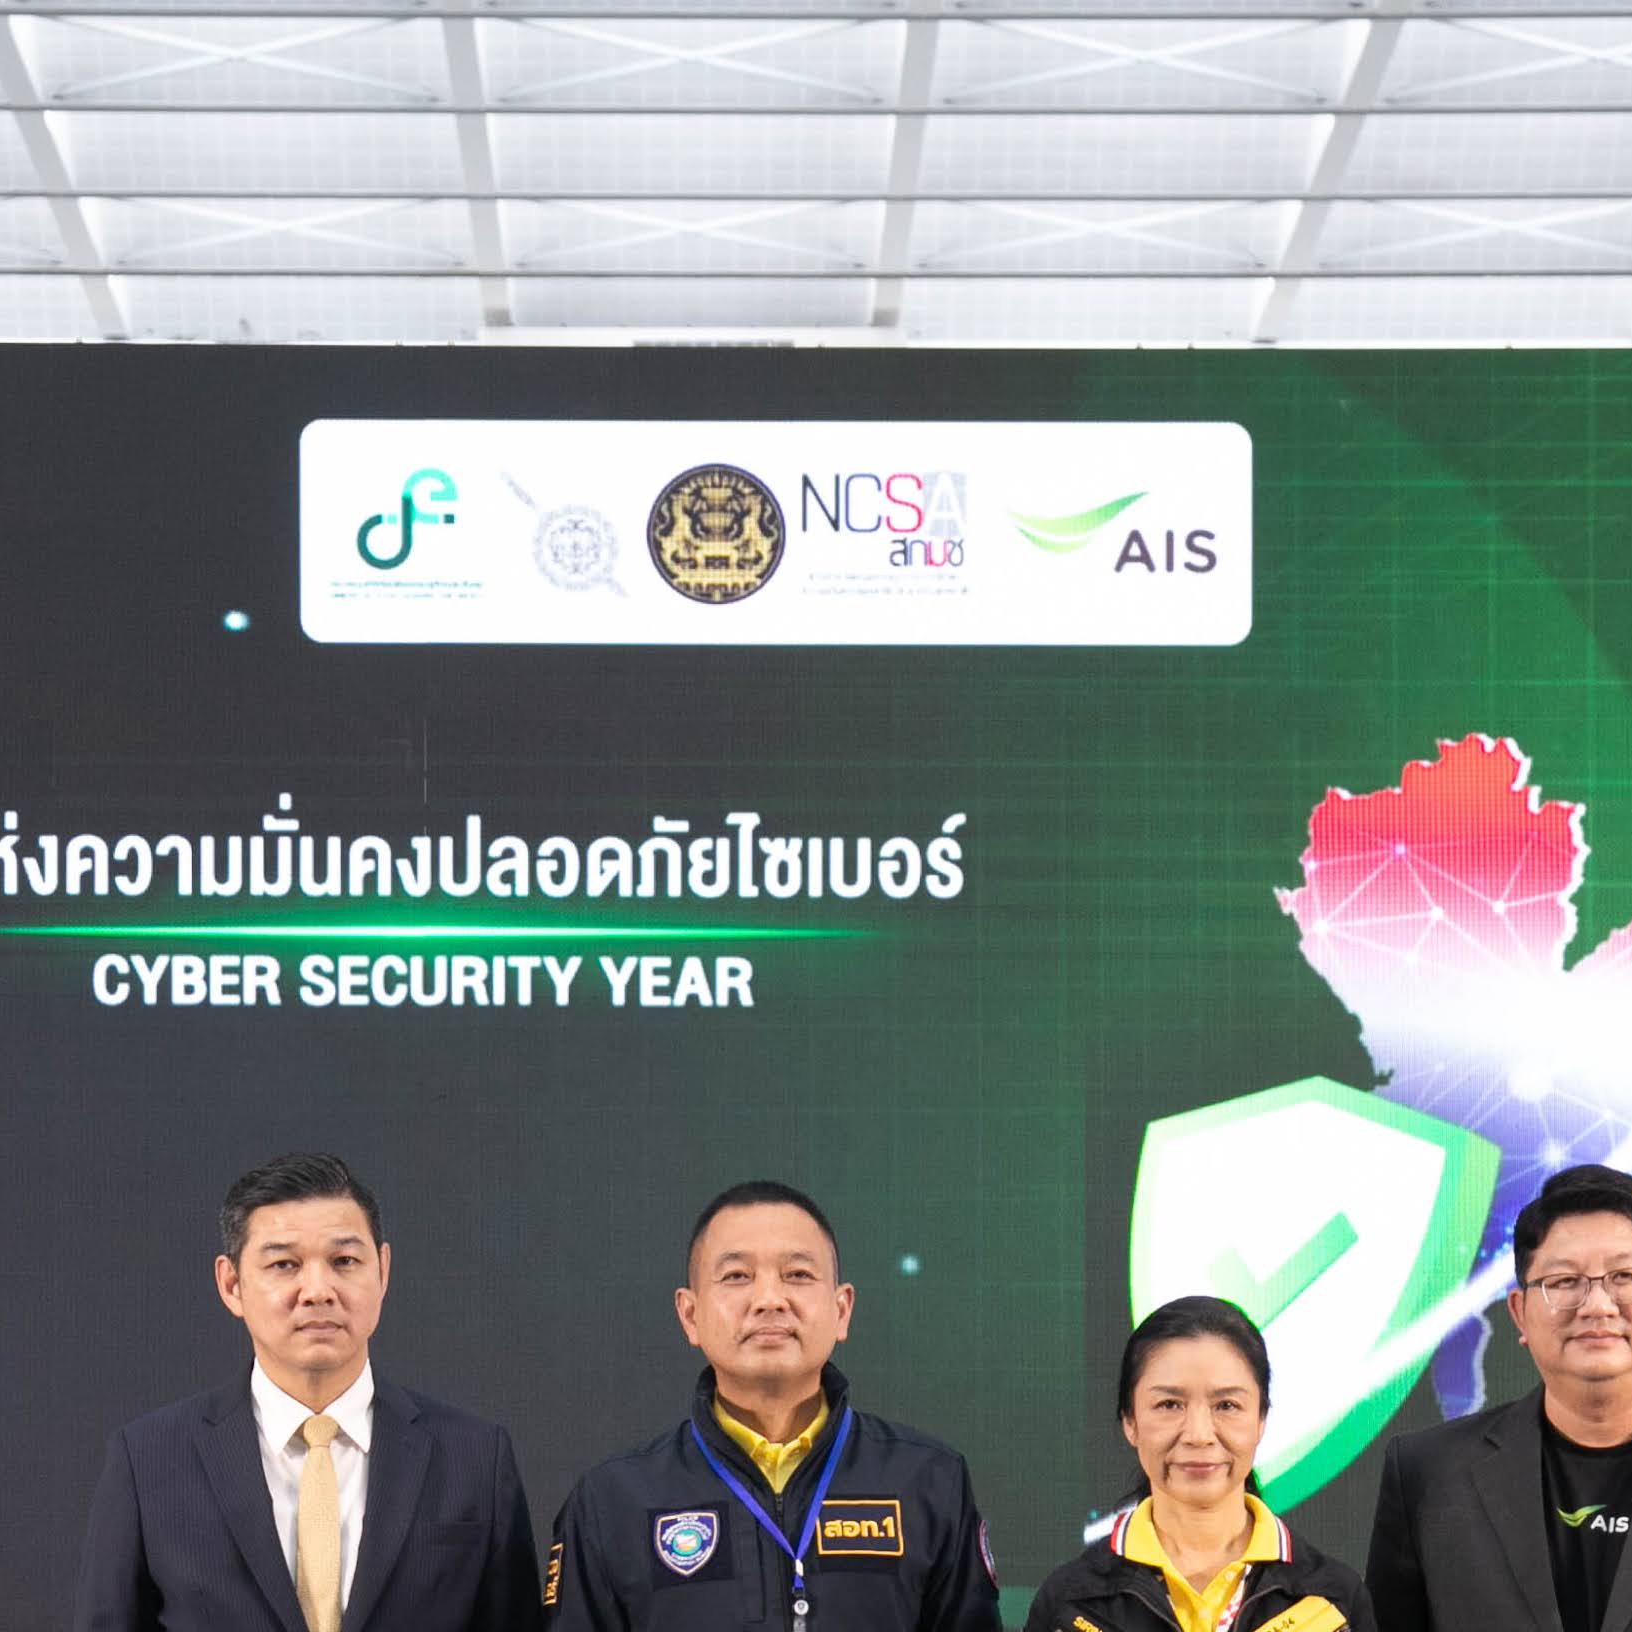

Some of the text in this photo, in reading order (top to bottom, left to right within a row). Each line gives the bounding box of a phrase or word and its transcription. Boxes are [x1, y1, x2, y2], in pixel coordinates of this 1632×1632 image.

[802, 472, 968, 537] NCSA
[889, 537, 965, 568] สกมช
[1114, 528, 1218, 574] AIS
[94, 953, 755, 1006] CYBER SECURITY YEAR
[1590, 1514, 1630, 1534] AIS
